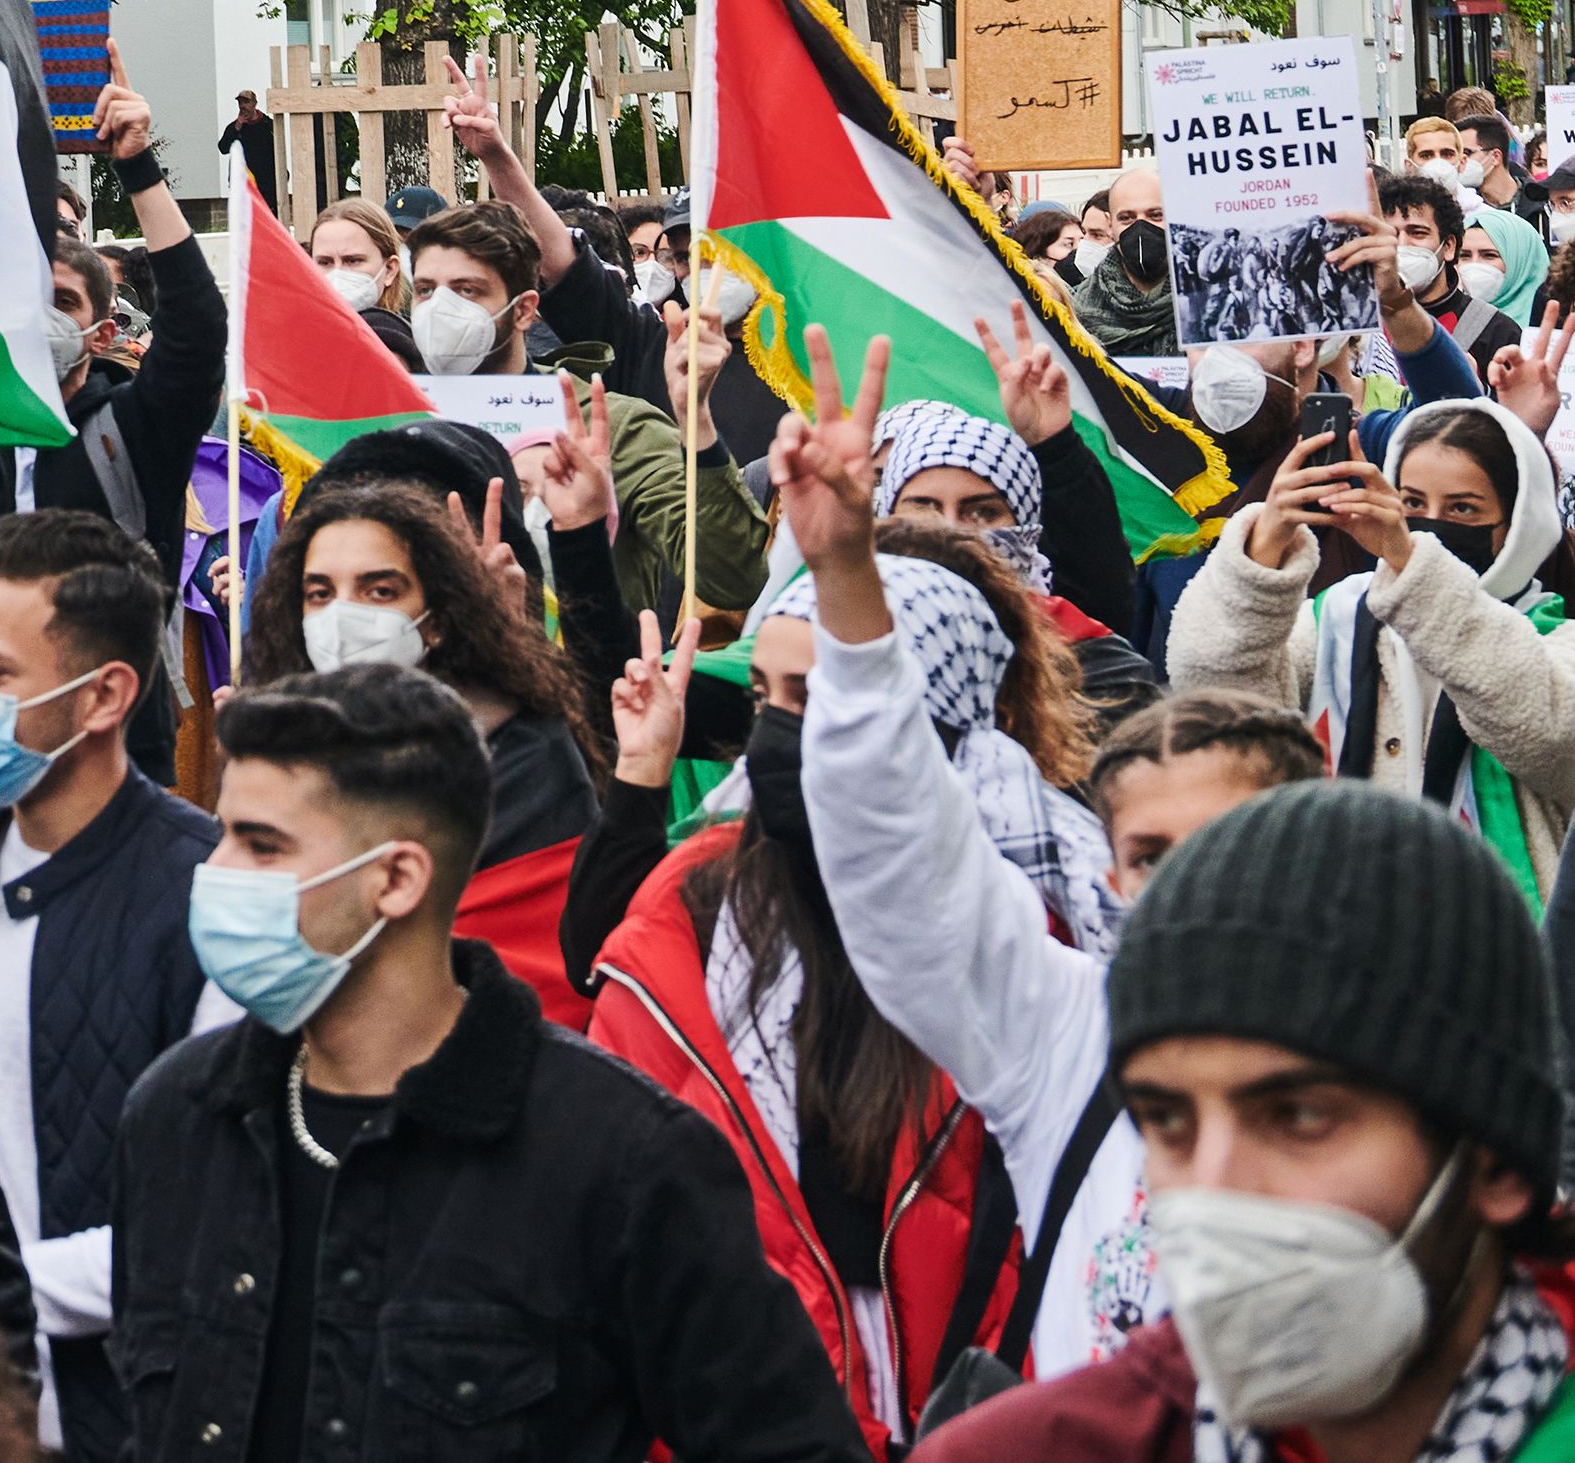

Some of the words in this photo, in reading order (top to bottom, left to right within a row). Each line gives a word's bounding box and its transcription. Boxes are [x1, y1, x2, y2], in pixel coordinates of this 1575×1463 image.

[1201, 93, 1219, 106] WE
[1225, 89, 1258, 104] WILL
[1162, 110, 1283, 143] JABAL
[1296, 105, 1355, 132] EL-
[1187, 140, 1338, 176] HUSSEIN
[1240, 178, 1292, 194] JORDAN
[1215, 197, 1277, 214] FOUNDED
[1285, 193, 1320, 208] 1952
